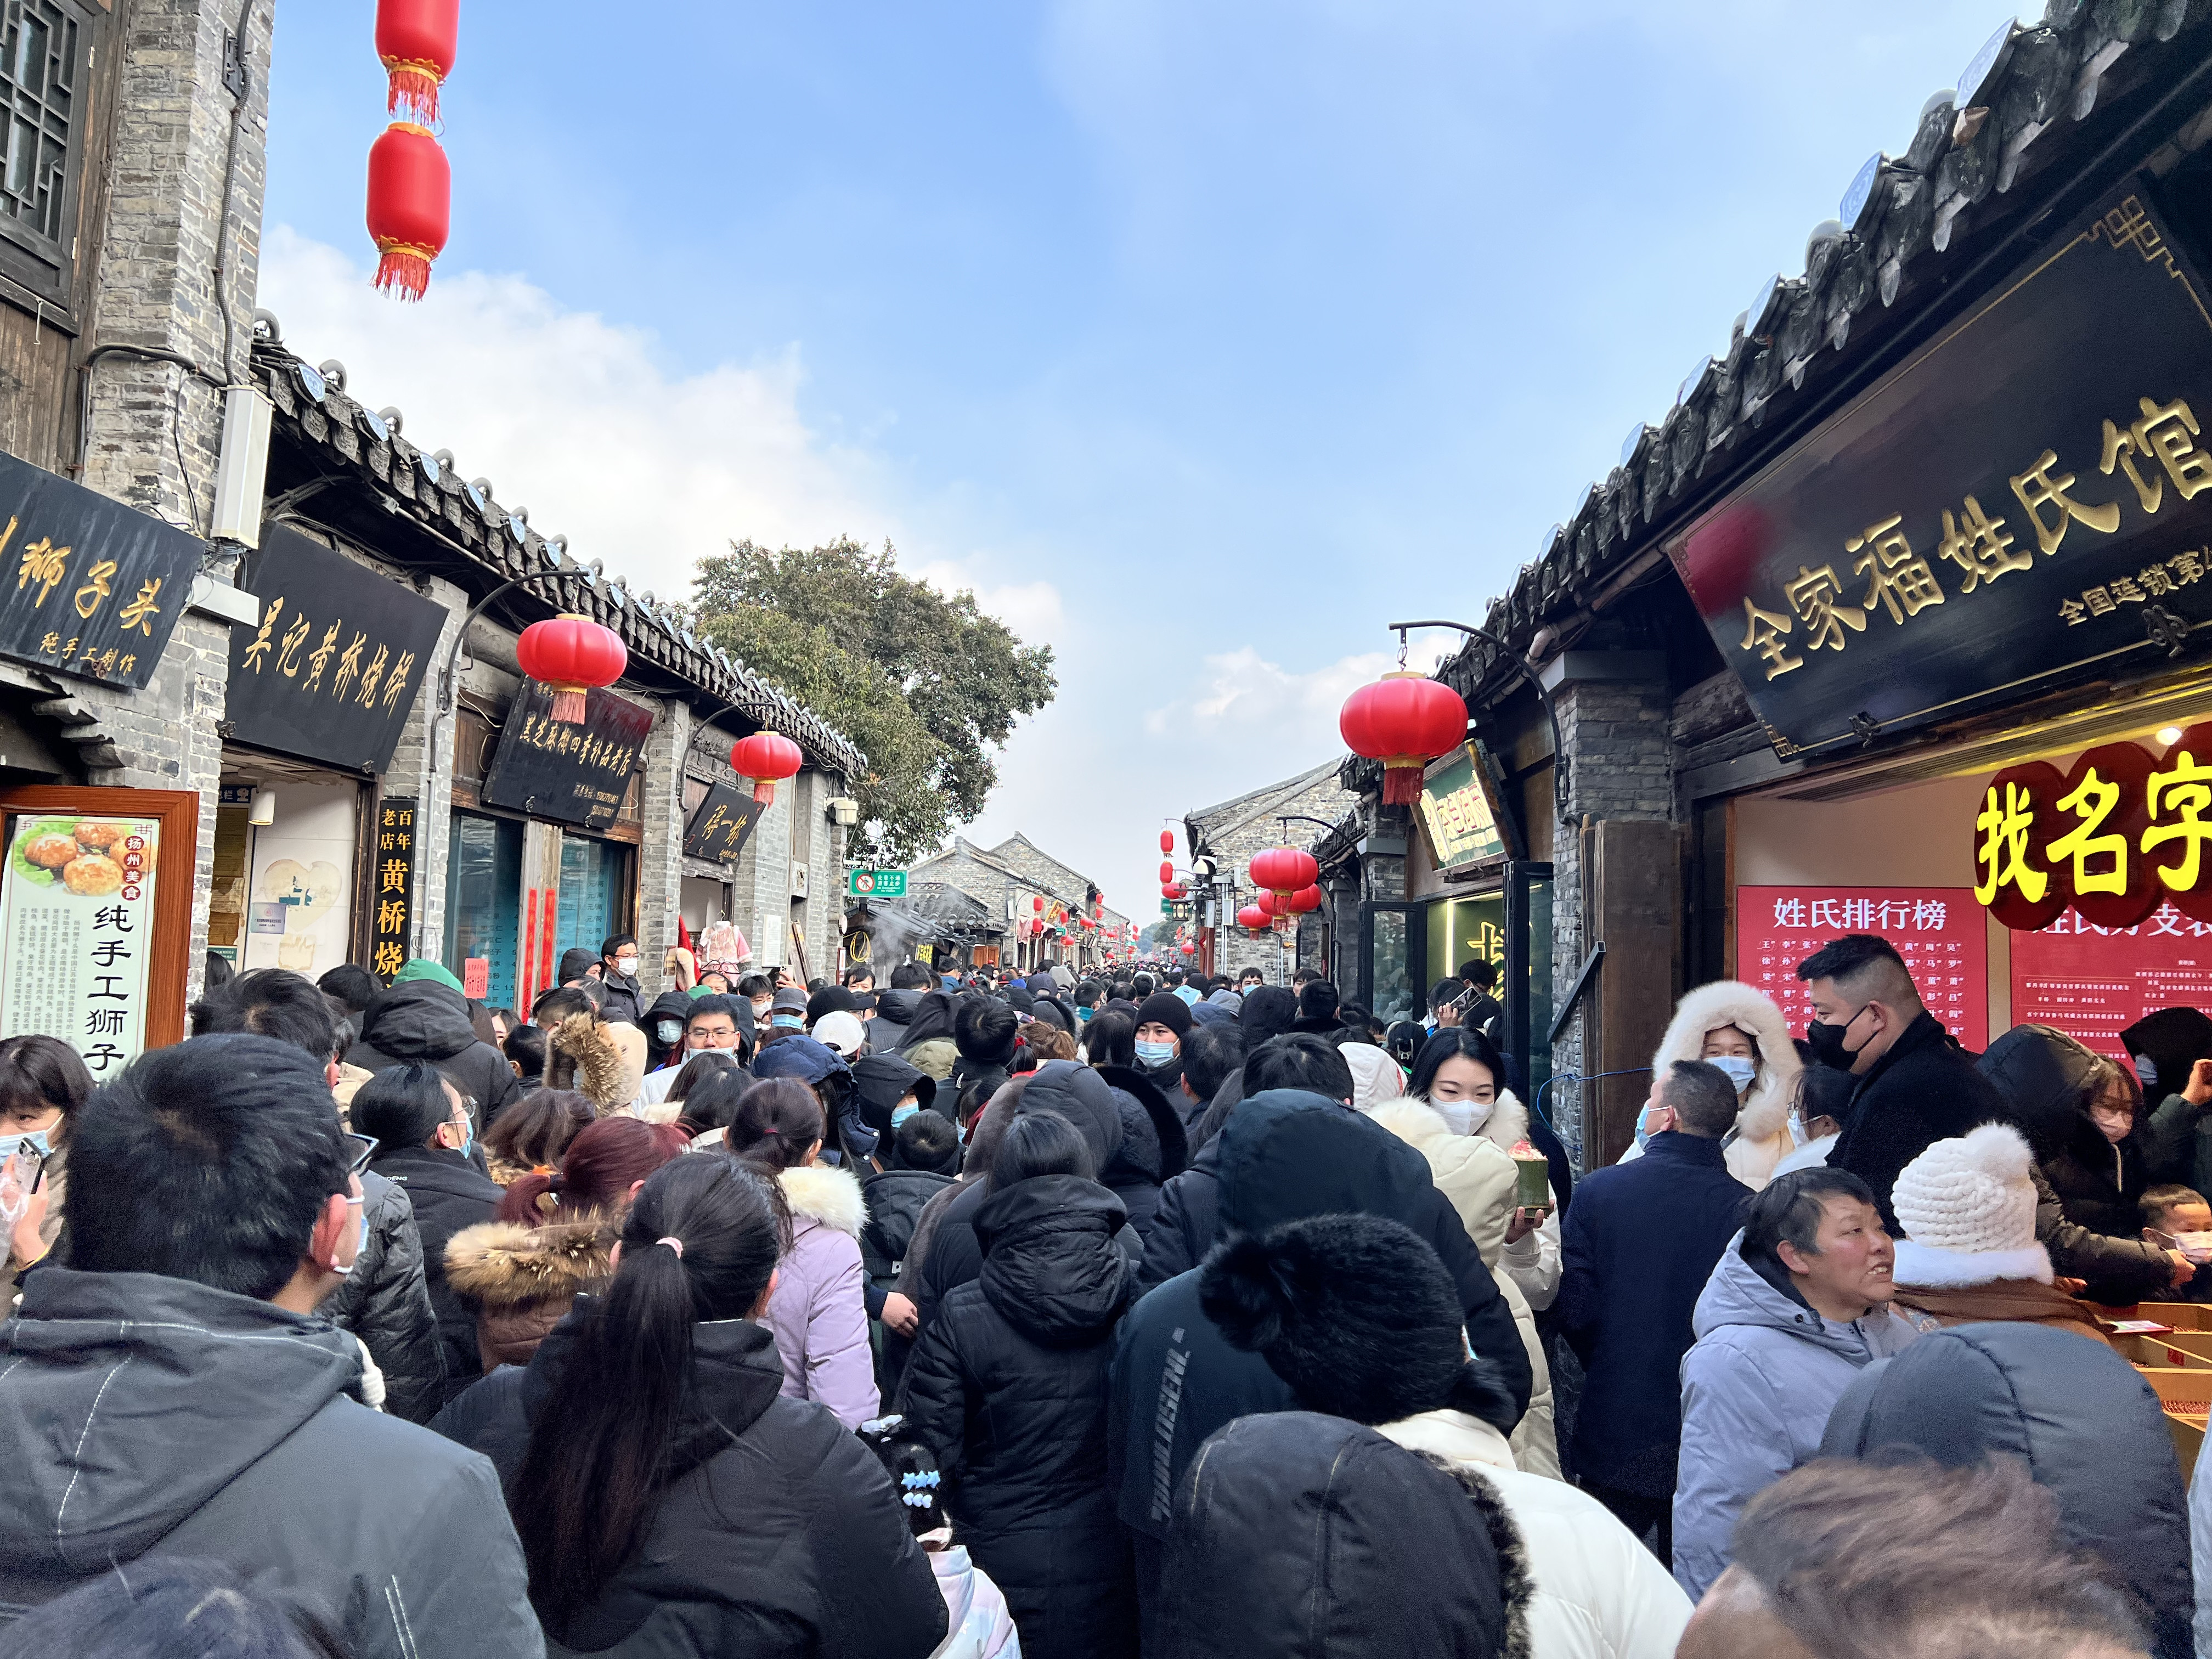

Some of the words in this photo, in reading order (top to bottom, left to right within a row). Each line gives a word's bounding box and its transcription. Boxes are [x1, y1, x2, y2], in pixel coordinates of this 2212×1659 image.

[0, 515, 161, 636] 狮子头
[1740, 397, 2212, 681] 全家福姓氏馆
[2058, 545, 2212, 627] 全国连锁第
[40, 631, 137, 676] 纯手工制作
[124, 837, 143, 899] 扬州美食
[1974, 750, 2212, 906] 找名字
[374, 859, 409, 988] 黄桥烧
[1773, 898, 1947, 932] 姓氏排行榜
[1782, 941, 1790, 949] 李
[1802, 941, 1810, 949] 张
[83, 904, 134, 1071] 纯手工狮子
[1949, 993, 1957, 1001] 吕
